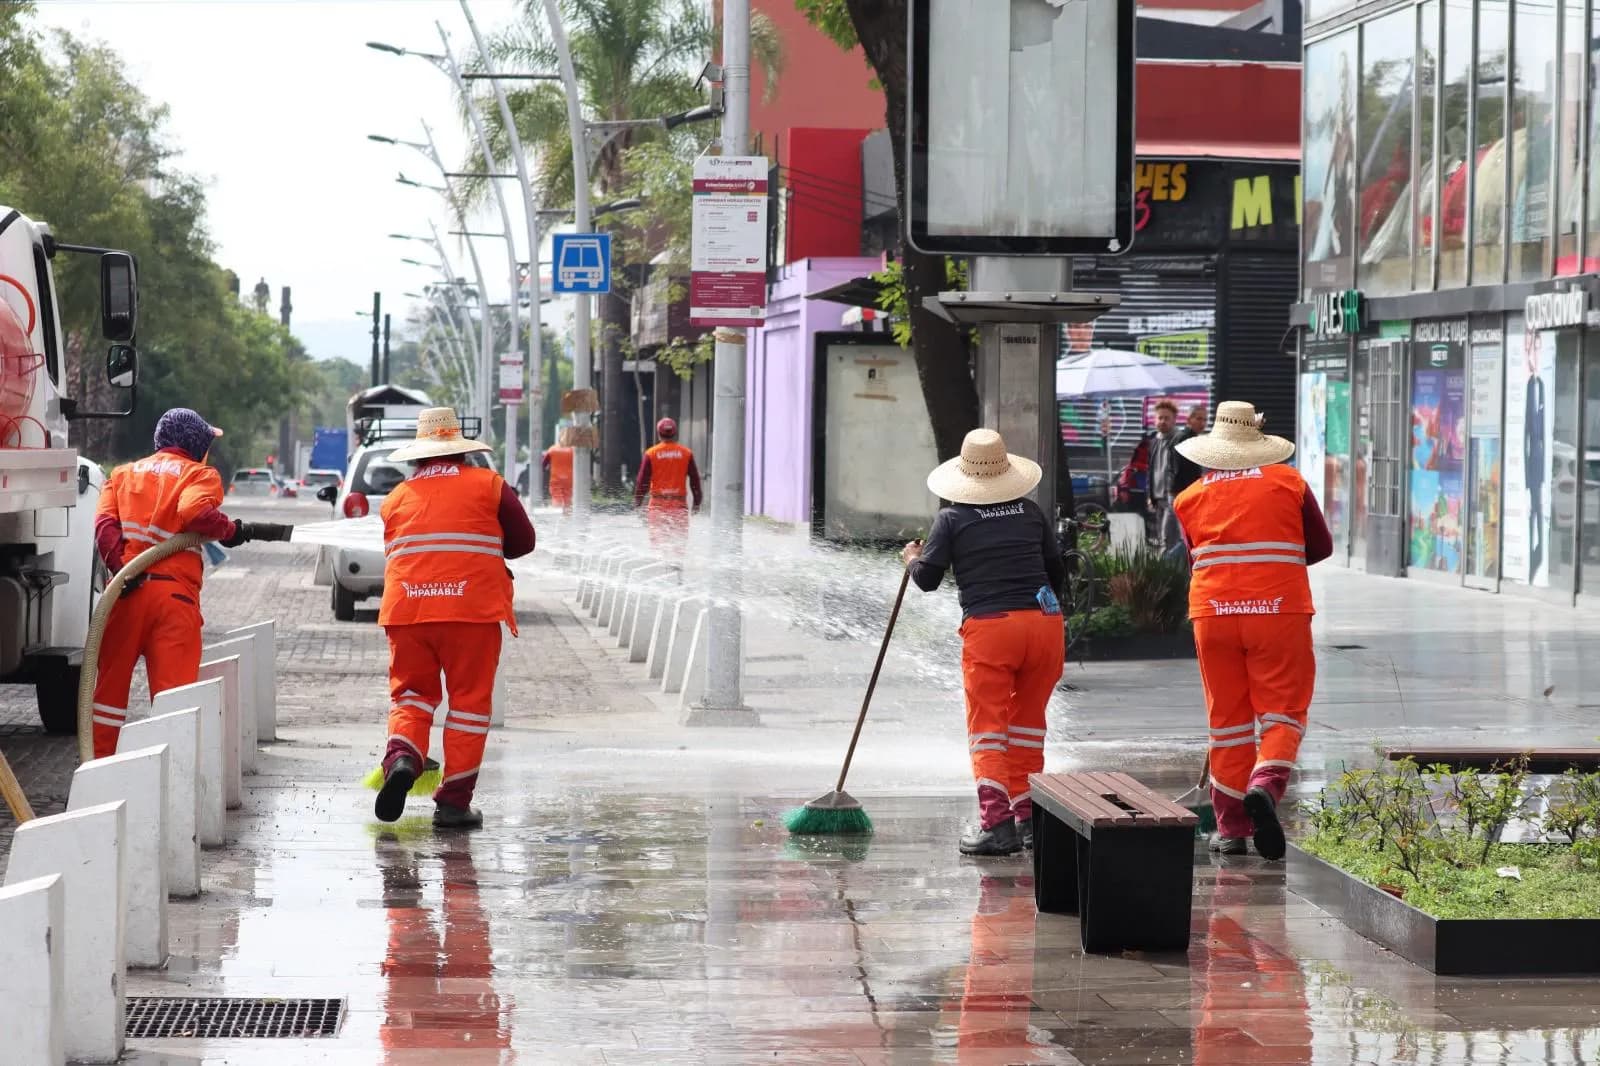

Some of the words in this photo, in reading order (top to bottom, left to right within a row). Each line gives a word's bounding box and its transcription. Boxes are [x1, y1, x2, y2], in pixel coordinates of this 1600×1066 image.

[1441, 322, 1450, 341] DE
[981, 507, 1024, 519] IMPARABLE
[407, 588, 464, 598] IMPARABLE
[1216, 605, 1280, 616] IMPARABLE
